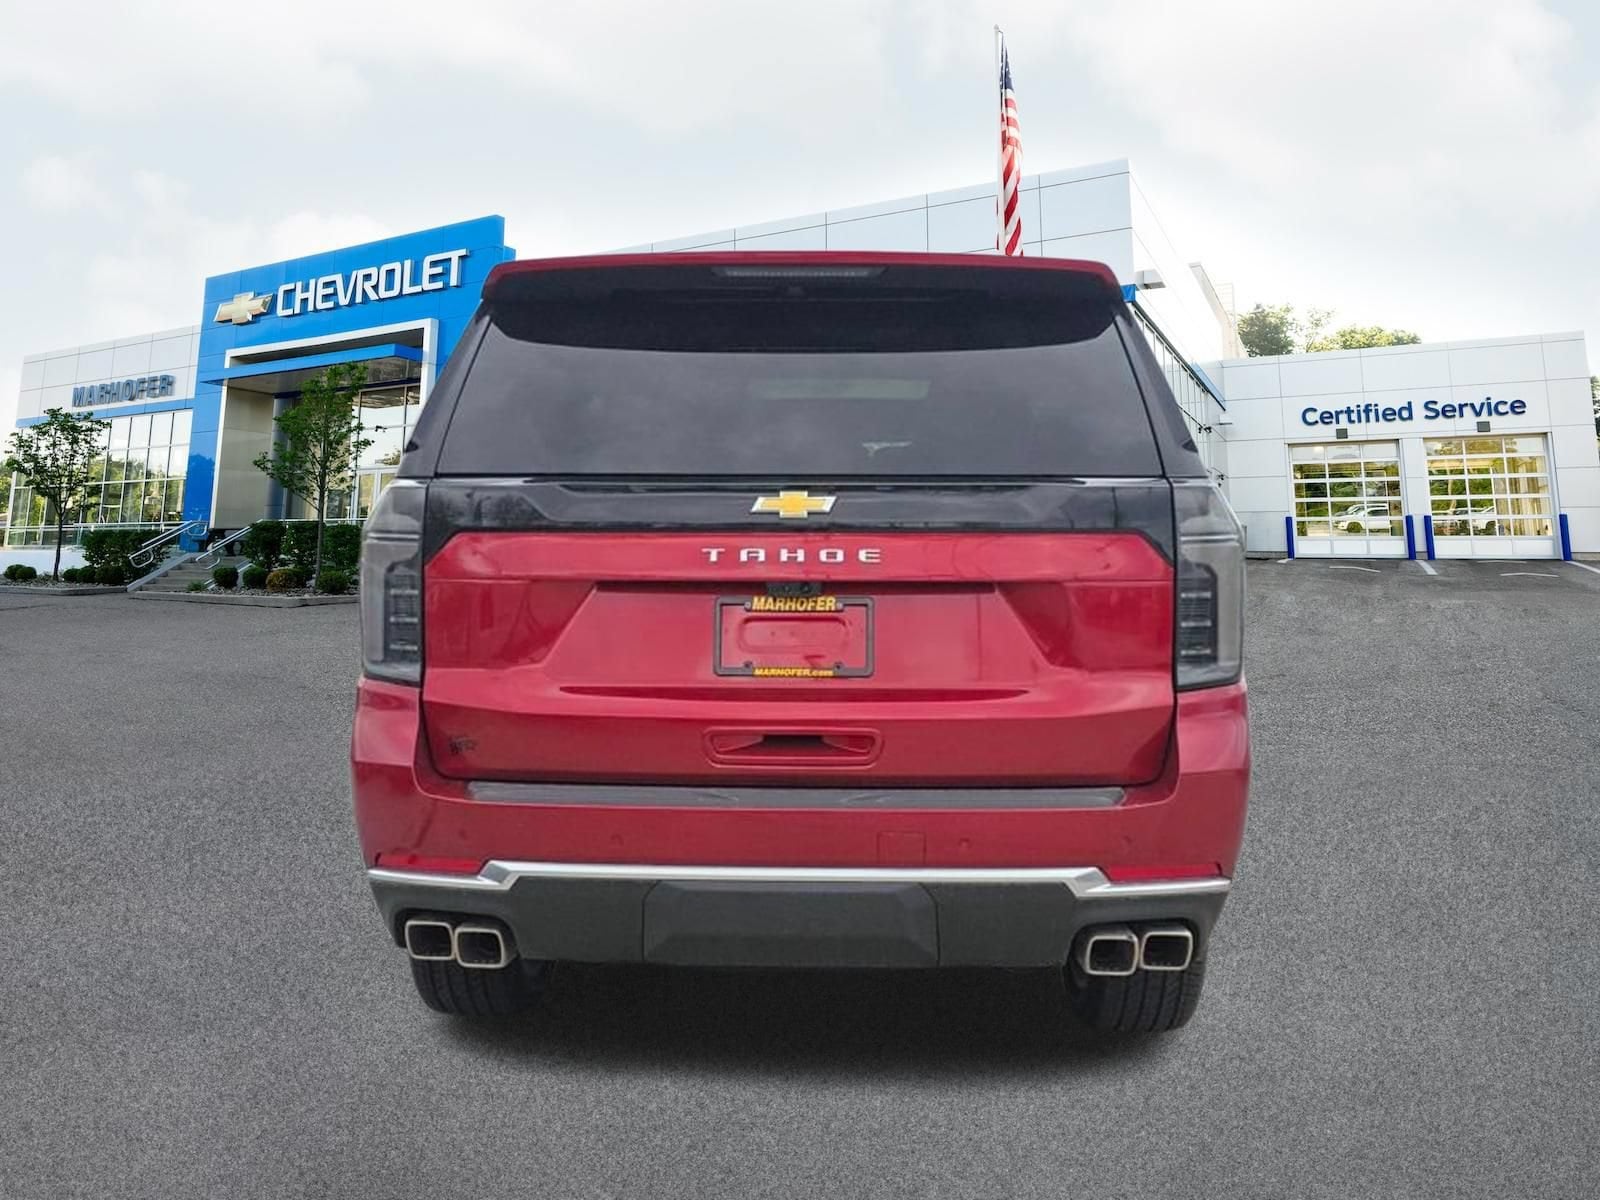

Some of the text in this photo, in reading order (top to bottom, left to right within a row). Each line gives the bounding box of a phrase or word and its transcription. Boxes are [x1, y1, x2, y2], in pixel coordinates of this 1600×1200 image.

[276, 248, 468, 317] CHEVROLET
[71, 374, 176, 408] MARHOFER
[1301, 397, 1527, 426] Certified Service
[701, 548, 882, 563] TAHOE
[752, 596, 836, 611] MARHOFER
